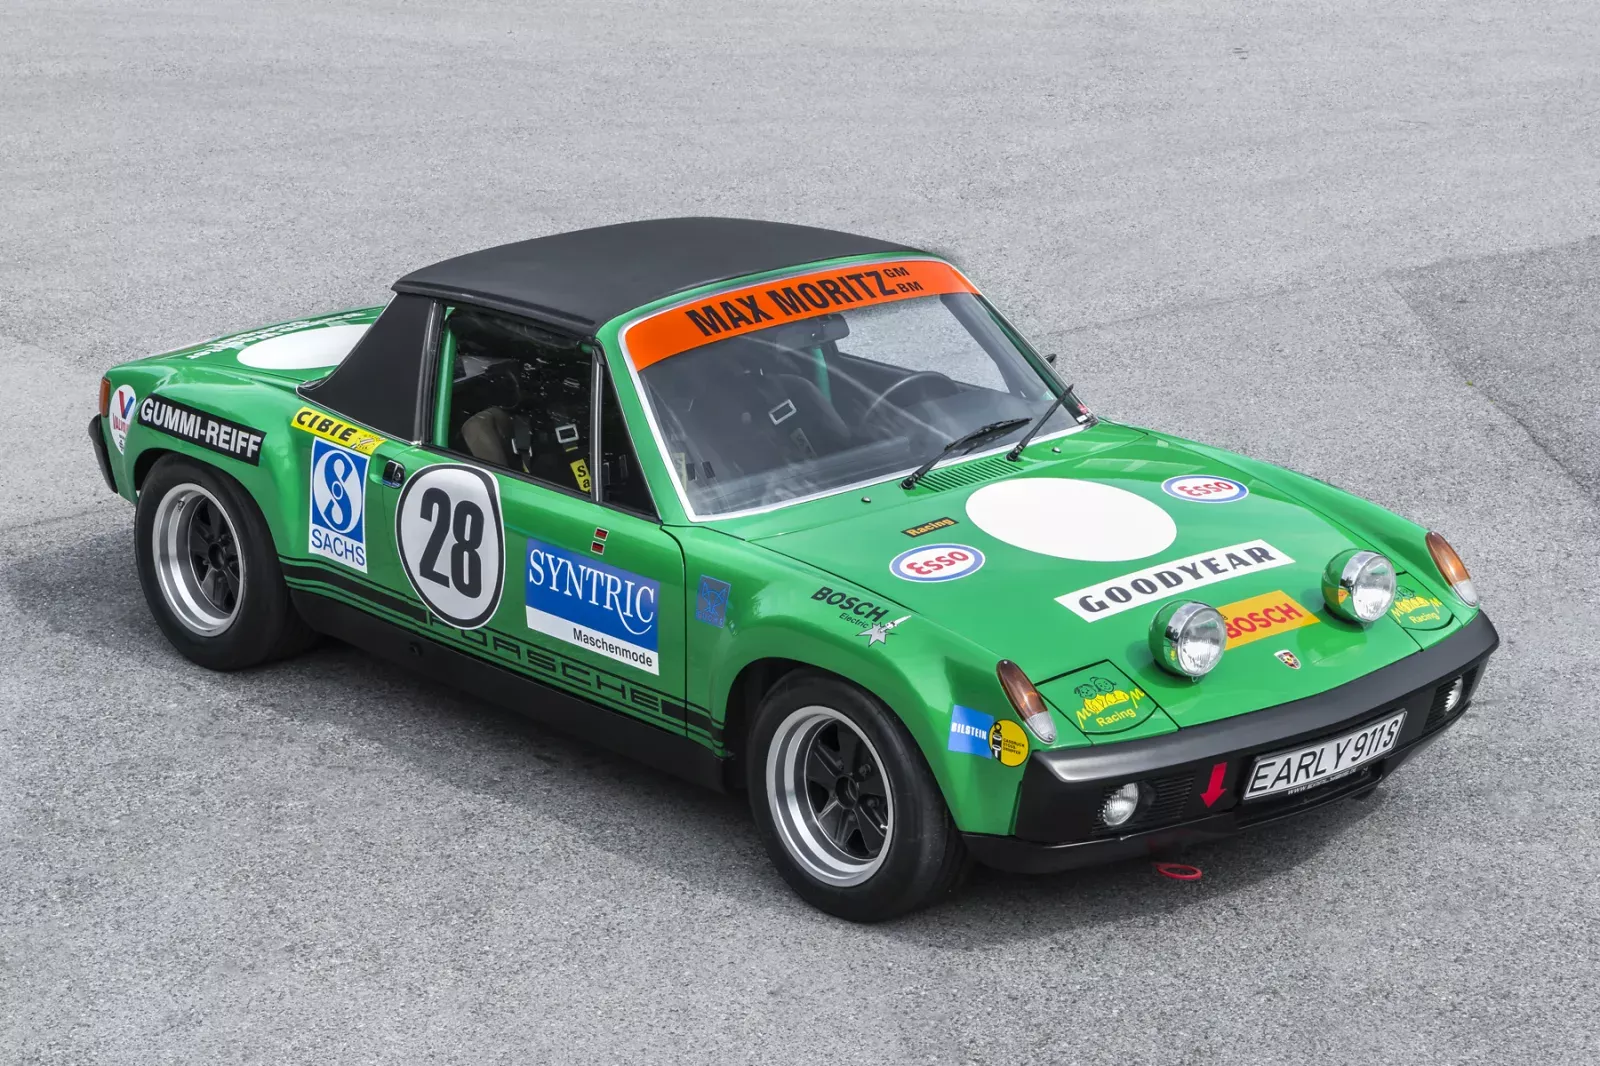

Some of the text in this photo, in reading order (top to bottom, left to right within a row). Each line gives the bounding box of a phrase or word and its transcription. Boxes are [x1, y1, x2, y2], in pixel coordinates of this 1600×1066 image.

[882, 266, 911, 278] GM
[685, 271, 897, 337] MAX MORITZ
[140, 397, 262, 458] GUMMI-REIFF
[296, 410, 358, 442] CIBIE
[419, 487, 484, 599] 28
[905, 517, 956, 537] Racing
[311, 528, 366, 567] SACHS
[529, 548, 654, 635] SYNTRIC
[1078, 546, 1277, 613] GOODYEAR
[811, 586, 889, 622] BOSCH
[839, 612, 870, 629] Electric
[1226, 602, 1304, 640] BOSCH
[1408, 612, 1441, 624] Racing
[573, 627, 653, 667] Maschenmode
[951, 722, 988, 740] BILSTEIN
[1096, 708, 1137, 727] Racing
